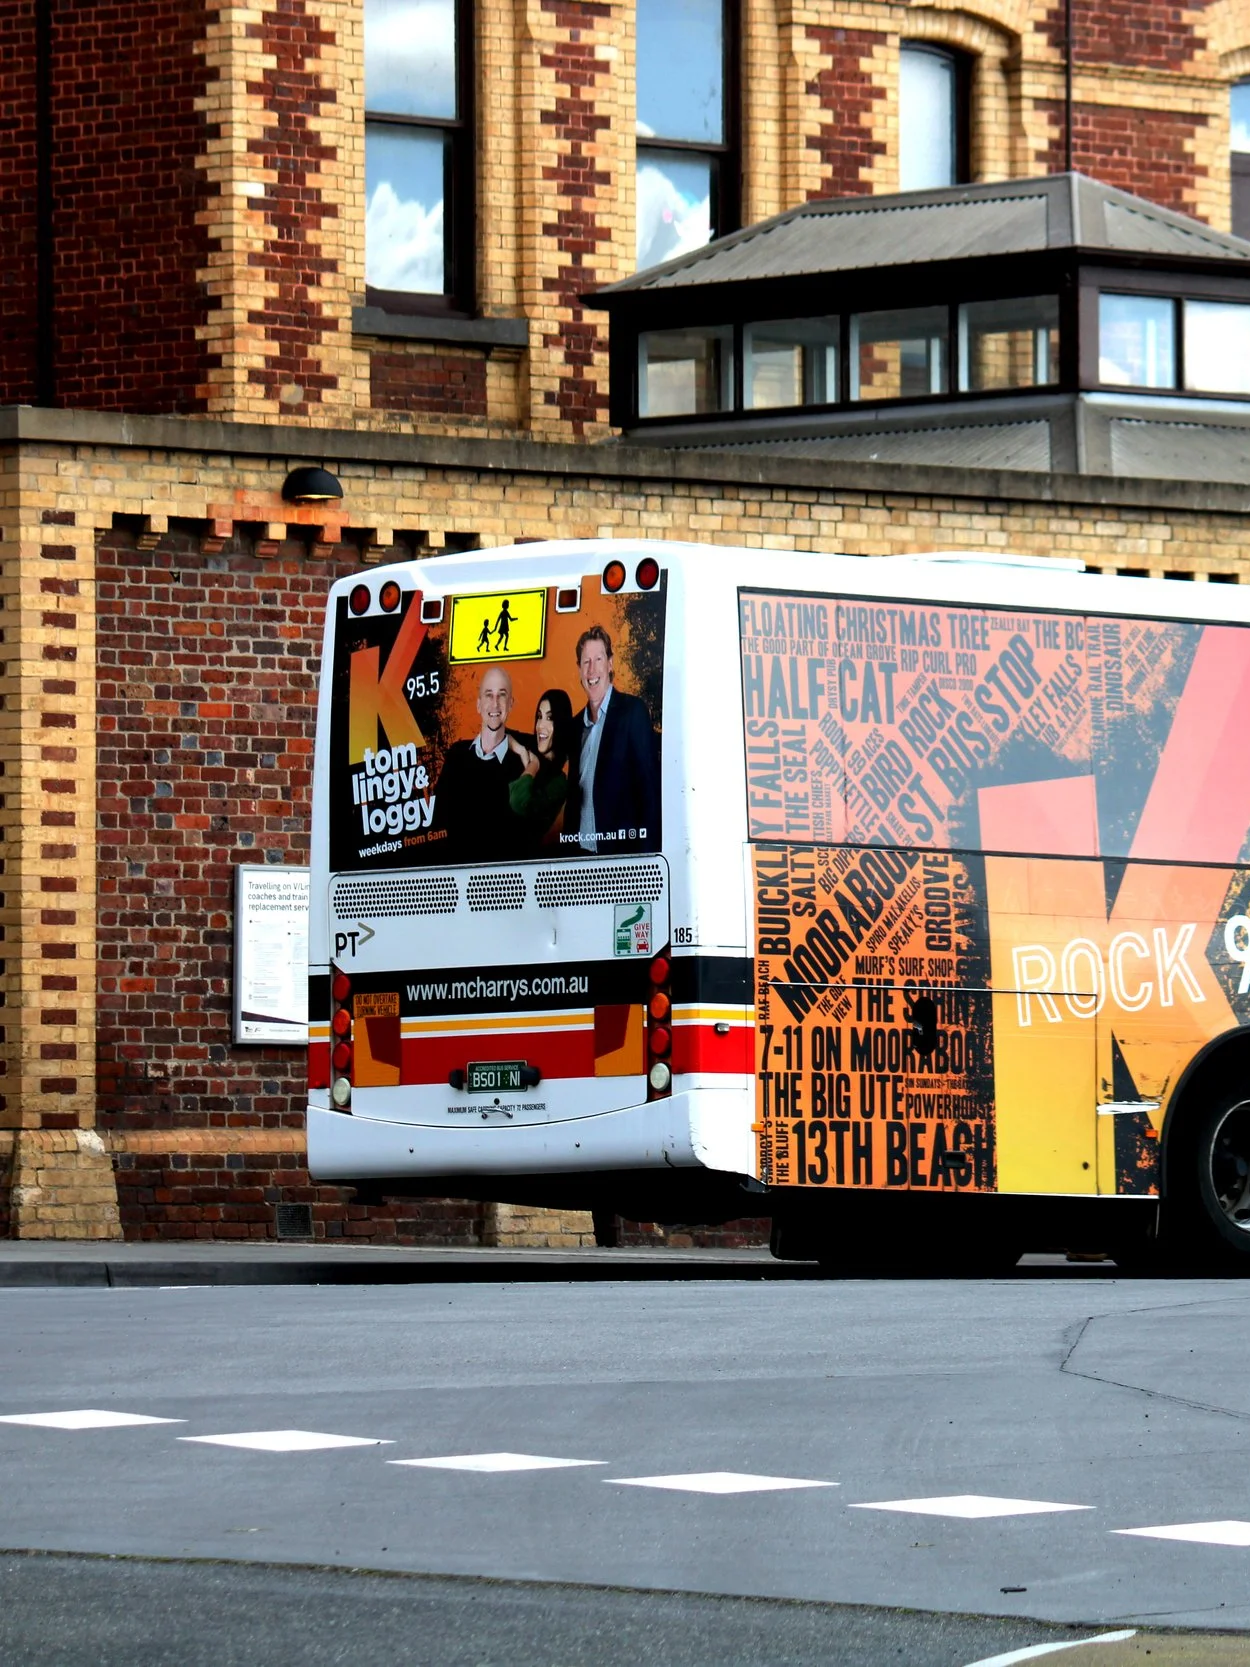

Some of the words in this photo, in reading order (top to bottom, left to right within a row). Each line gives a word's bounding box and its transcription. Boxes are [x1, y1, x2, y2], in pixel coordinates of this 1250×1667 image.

[740, 599, 829, 641] FLOATING
[835, 604, 942, 648] CHRISTMAS
[946, 612, 991, 652] TREE
[1032, 619, 1060, 649] THE
[1087, 623, 1101, 659] TRAIL
[741, 636, 759, 654] THE
[762, 638, 787, 655] GOOD
[790, 639, 814, 657] PART
[818, 640, 829, 657] OF
[832, 642, 863, 660] OCEAN
[866, 644, 897, 662] GROVE
[900, 649, 919, 673] RIP
[922, 651, 952, 675] CURL
[955, 653, 977, 676] PRO
[827, 659, 837, 677] PUB
[1043, 653, 1083, 712] FALLS
[1088, 666, 1103, 692] RAIL
[1102, 623, 1124, 712] DINOSAUR
[406, 671, 440, 700] 95.5
[743, 654, 826, 720] HALF
[838, 657, 898, 725] CAT
[781, 724, 808, 783] SEAL
[818, 711, 853, 757] ROOM
[848, 749, 866, 775] 99
[859, 739, 913, 813] BIRD
[898, 678, 957, 759] ROCK
[898, 772, 945, 842] ST
[927, 710, 991, 800] BUS
[974, 633, 1042, 734] STOP
[363, 742, 418, 777] tom
[747, 720, 783, 809] FALLS
[810, 769, 825, 810] CHIEFS
[361, 795, 436, 836] loggy
[784, 791, 810, 834] THE
[358, 838, 403, 858] weekdays
[403, 834, 426, 847] from
[427, 829, 448, 842] 6am
[559, 830, 617, 844] krock.com.au
[248, 881, 281, 892] Travelling
[278, 893, 291, 901] and
[292, 893, 309, 901] train
[788, 845, 817, 918] SALTY
[817, 868, 839, 895] BIG
[248, 903, 293, 912] replacement
[923, 853, 952, 952] GROOVE
[634, 922, 650, 931] GIVE
[634, 931, 649, 939] WAY
[674, 927, 693, 943] 185
[864, 925, 887, 954] SPIRO
[887, 904, 924, 955] SPEAKY'S
[758, 960, 770, 994] BEACH
[855, 956, 895, 976] MURF'S
[898, 957, 924, 977] SURF
[928, 958, 954, 978] SHOP
[1012, 924, 1206, 1027] ROCK
[405, 974, 589, 1003] www.mcharrys.com.au
[816, 994, 834, 1017] THE
[851, 977, 895, 1024] THE
[758, 998, 770, 1020] RAF
[831, 995, 853, 1023] VIEW
[759, 1024, 803, 1071] 7-11
[811, 1026, 842, 1072] ON
[521, 1103, 546, 1111] PASSENGERS
[759, 1072, 803, 1118] THE
[811, 1073, 851, 1119] BIG
[860, 1074, 904, 1120] UTE
[775, 1120, 789, 1160] BLUFF
[791, 1120, 874, 1185] 13TH
[885, 1121, 995, 1188] BEACH
[776, 1162, 790, 1185] THE
